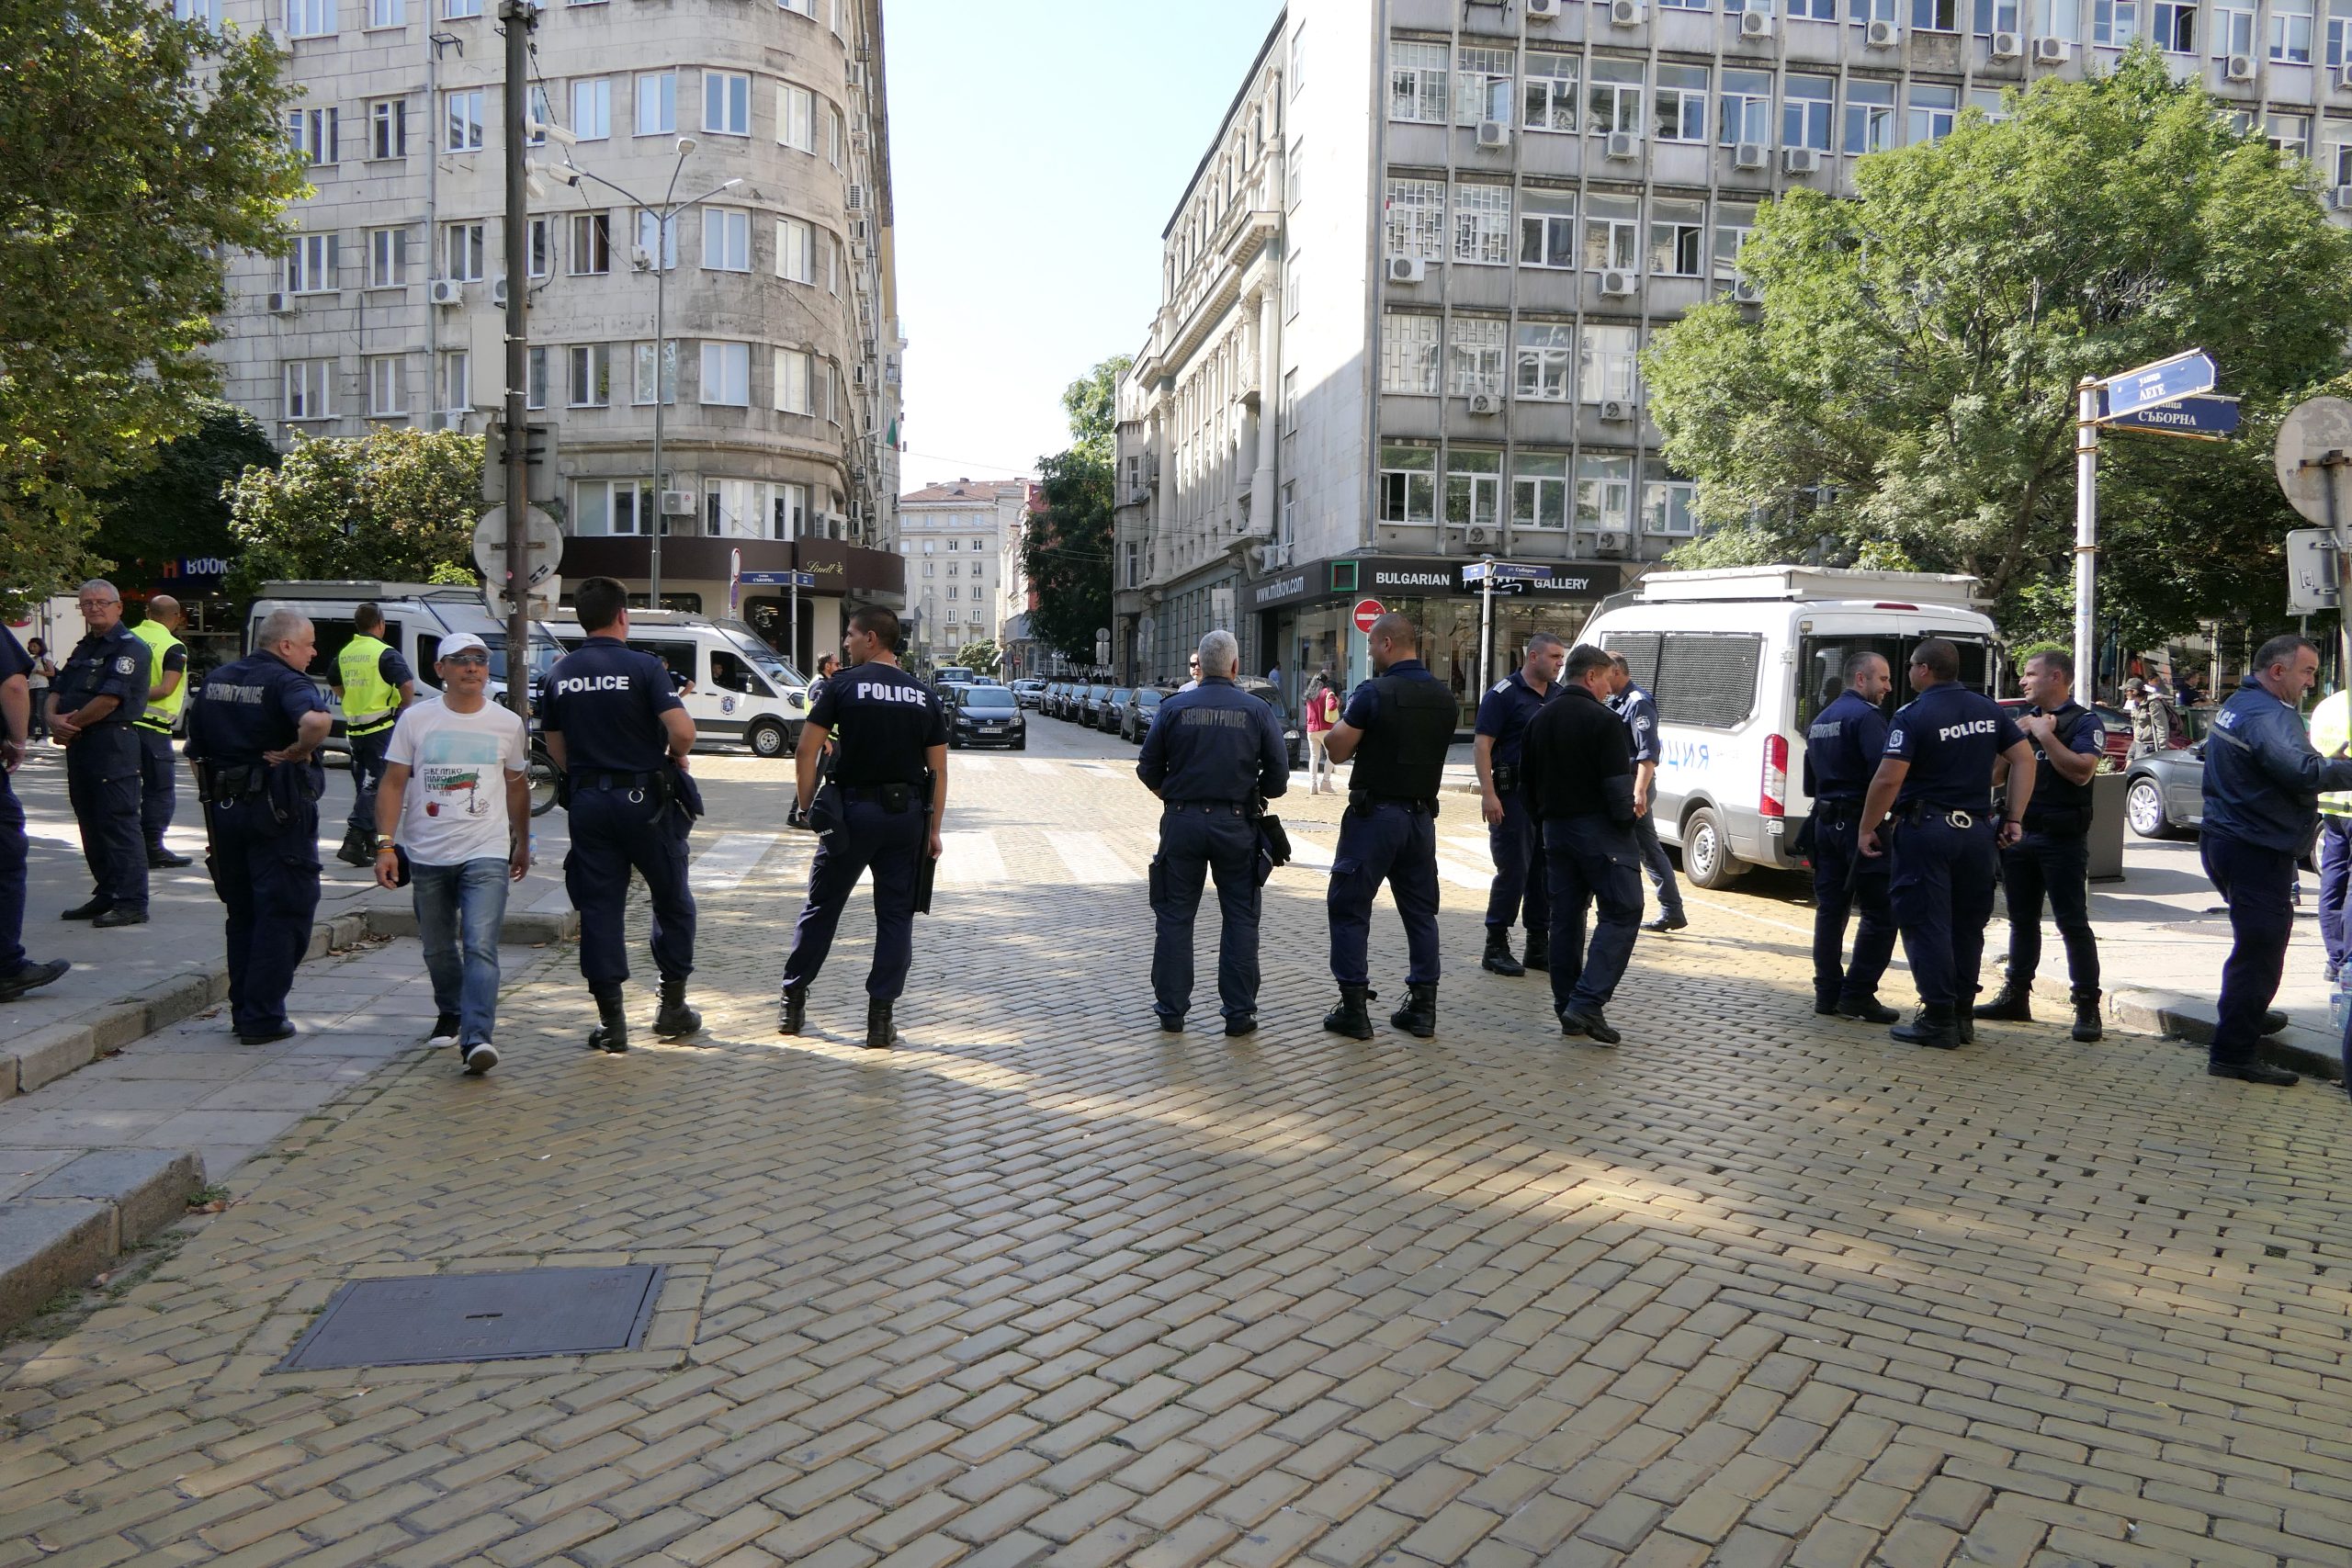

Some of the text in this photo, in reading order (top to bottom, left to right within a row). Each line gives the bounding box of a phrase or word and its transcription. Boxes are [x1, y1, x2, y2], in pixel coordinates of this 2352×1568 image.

[2139, 383, 2166, 400] ЛЕГЕ
[2138, 411, 2197, 426] СЪБОРНА
[806, 560, 835, 574] Lindt
[1255, 575, 1304, 604] www.mitkov.com
[1375, 571, 1450, 586] BULGARIAN
[1533, 577, 1589, 590] GALLERY
[558, 675, 629, 695] POLICE
[857, 682, 927, 707] POLICE
[1181, 707, 1248, 728] SECURITY POLICE
[1939, 719, 1996, 741] POLICE
